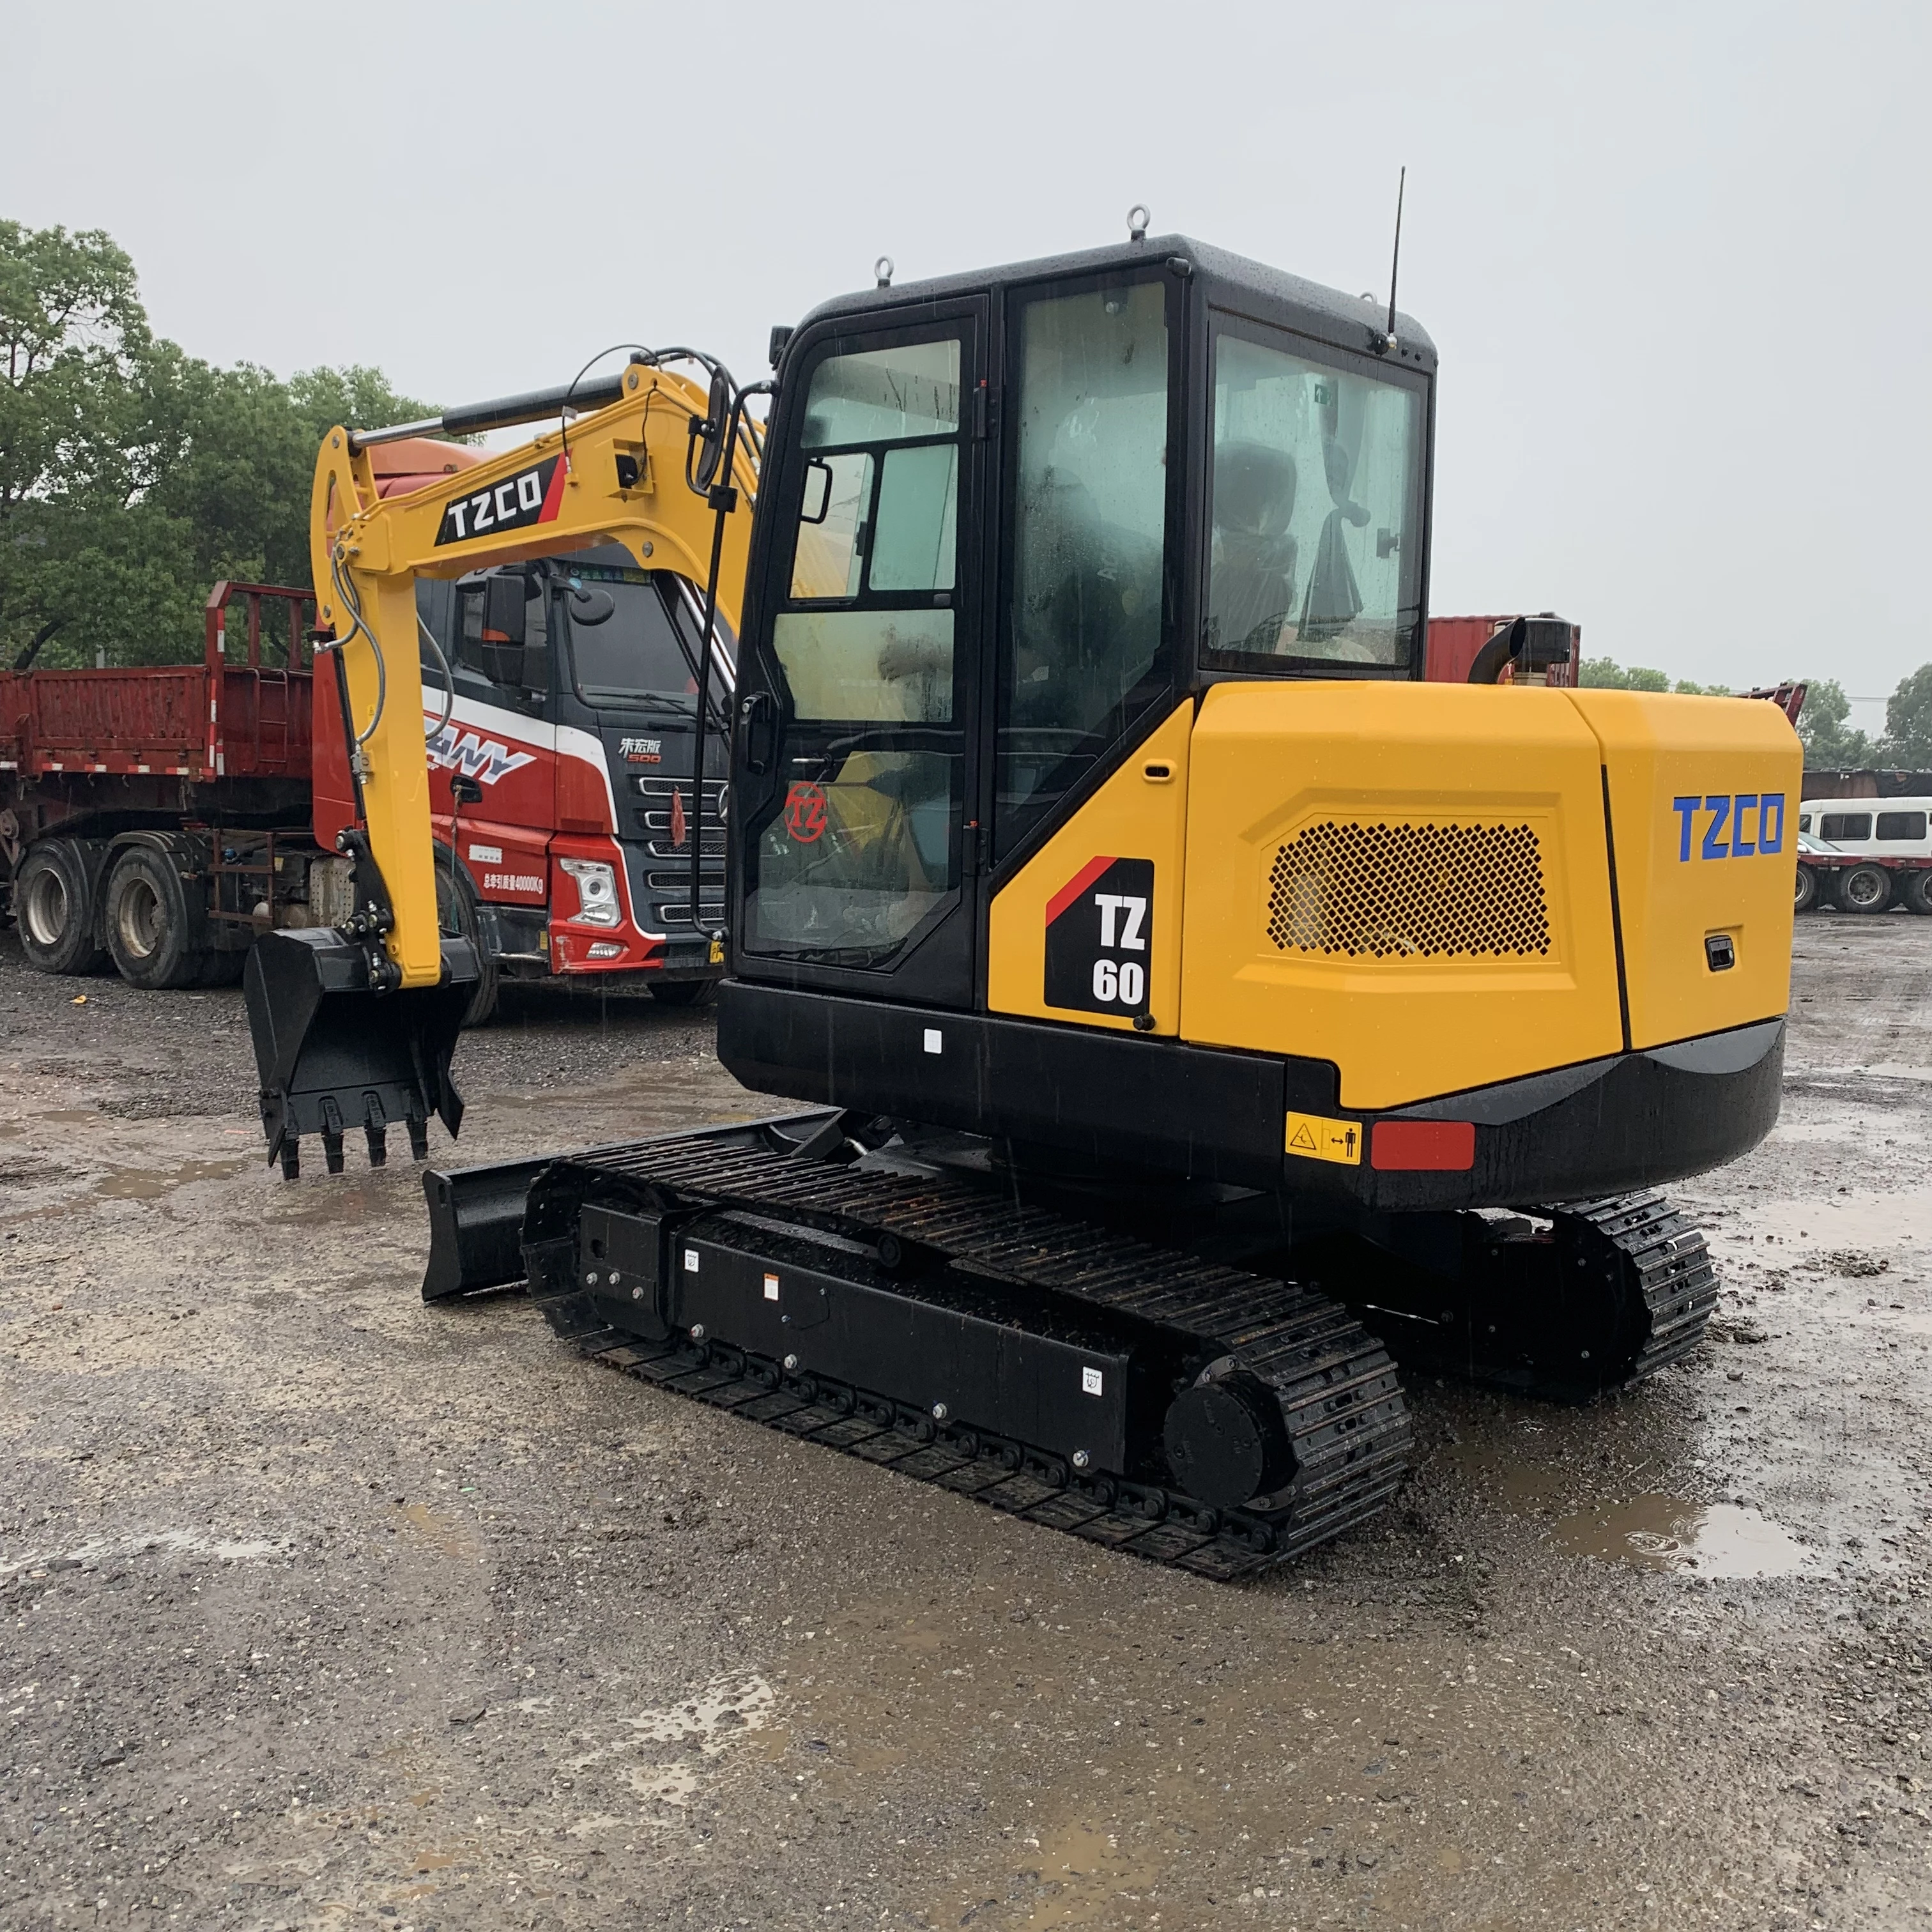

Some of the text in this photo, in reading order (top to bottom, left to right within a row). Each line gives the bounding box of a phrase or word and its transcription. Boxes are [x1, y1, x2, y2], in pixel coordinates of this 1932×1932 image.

[448, 471, 542, 537] TZCO
[424, 716, 537, 785] ANY
[627, 754, 661, 764] 500
[1673, 792, 1786, 863] TZCO
[1094, 893, 1147, 951] TZ
[1092, 958, 1144, 1006] 60
